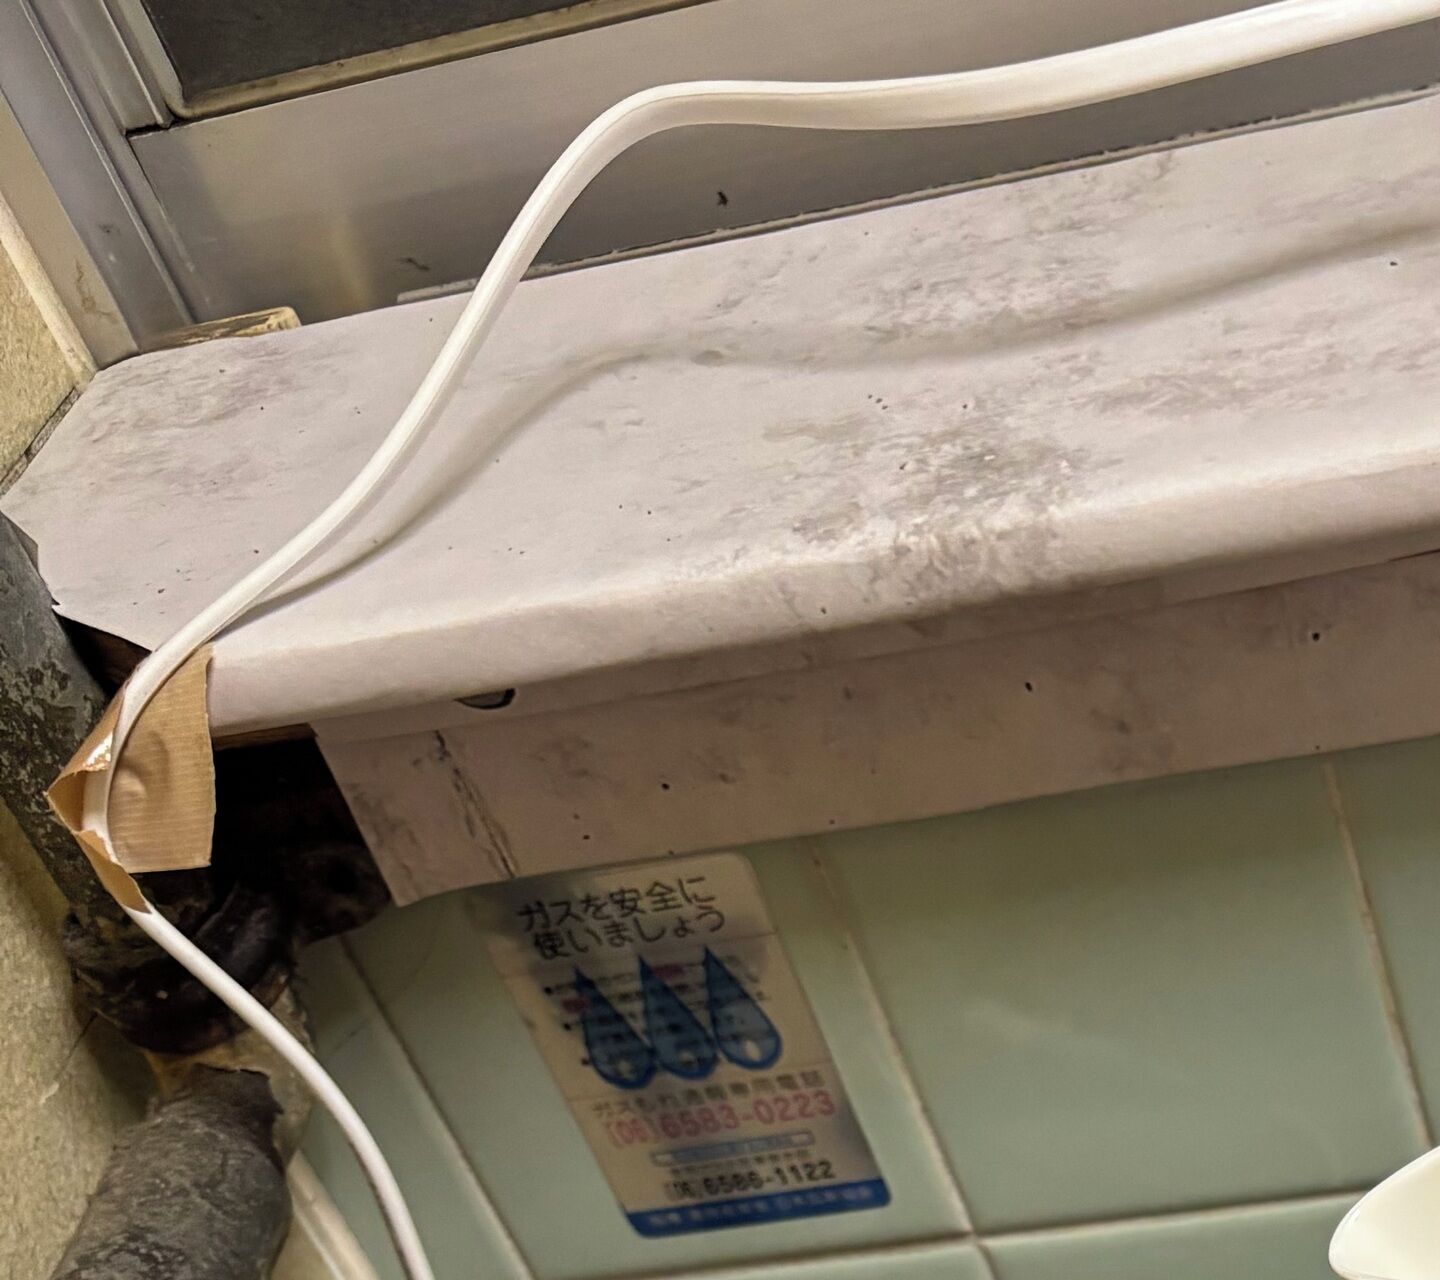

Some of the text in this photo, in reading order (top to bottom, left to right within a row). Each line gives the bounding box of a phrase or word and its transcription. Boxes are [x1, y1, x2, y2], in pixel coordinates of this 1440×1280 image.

[517, 877, 716, 933] ガスを安全に
[533, 907, 726, 960] 使いましょう
